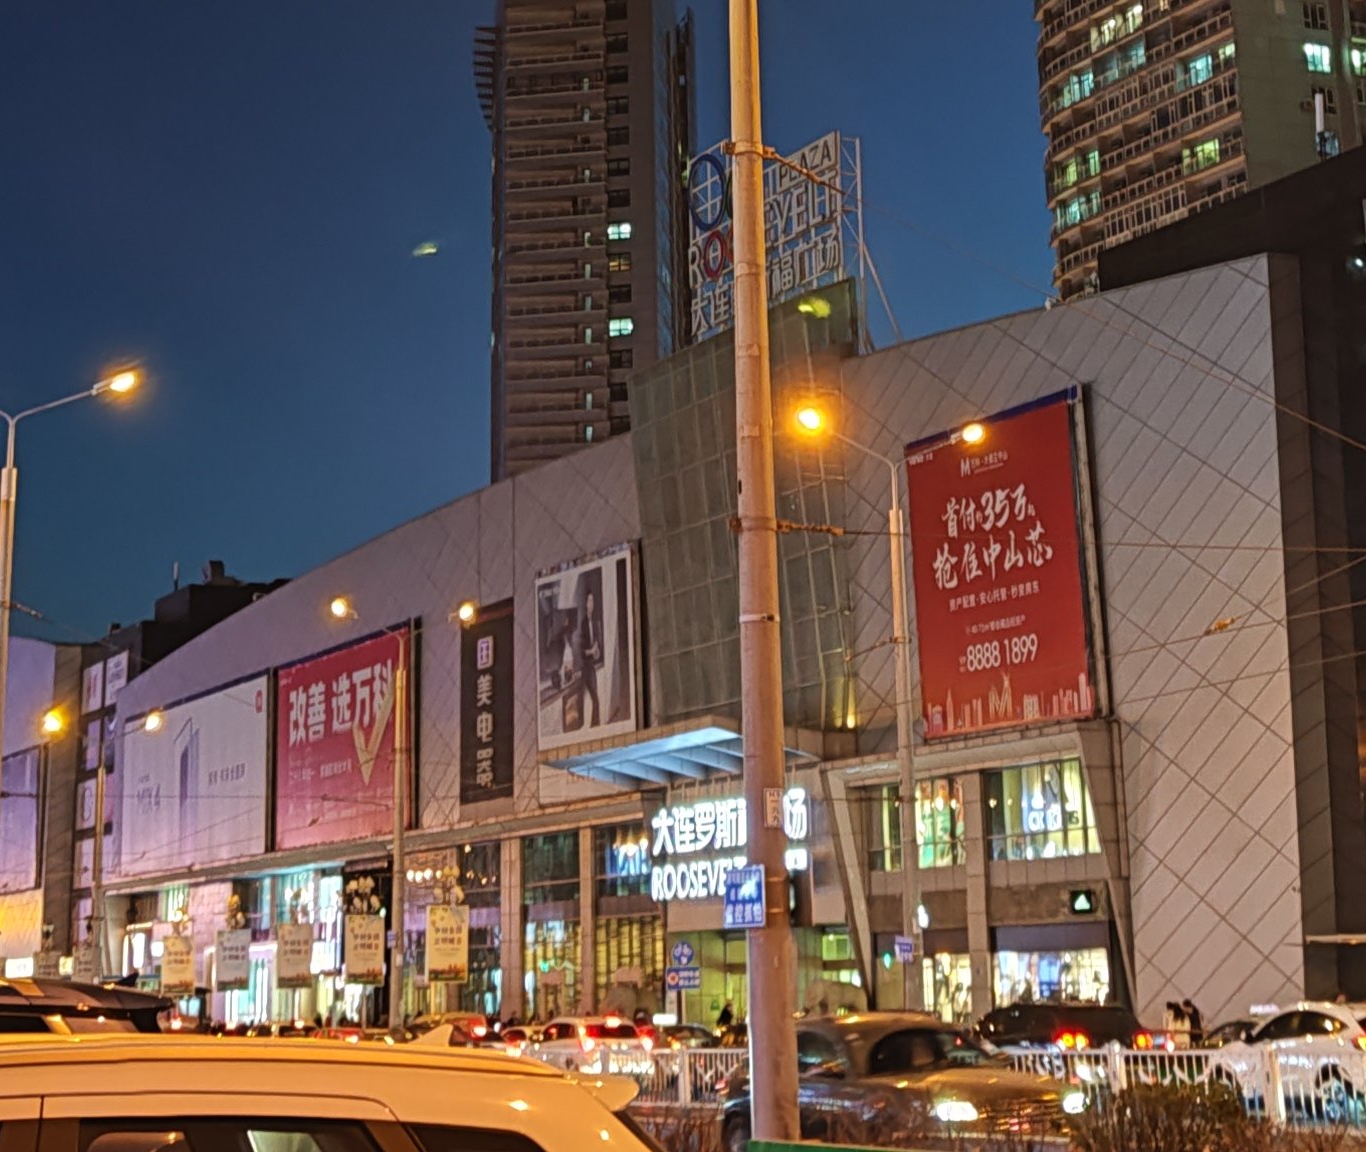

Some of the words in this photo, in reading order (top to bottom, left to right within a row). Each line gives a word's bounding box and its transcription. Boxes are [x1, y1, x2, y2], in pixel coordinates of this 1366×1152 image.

[779, 139, 832, 189] PLAZA
[967, 641, 1001, 672] 8888
[1004, 633, 1038, 665] 1899
[289, 681, 327, 747] 改善
[476, 635, 494, 787] 国美电器
[651, 787, 808, 856] 大连罗斯场
